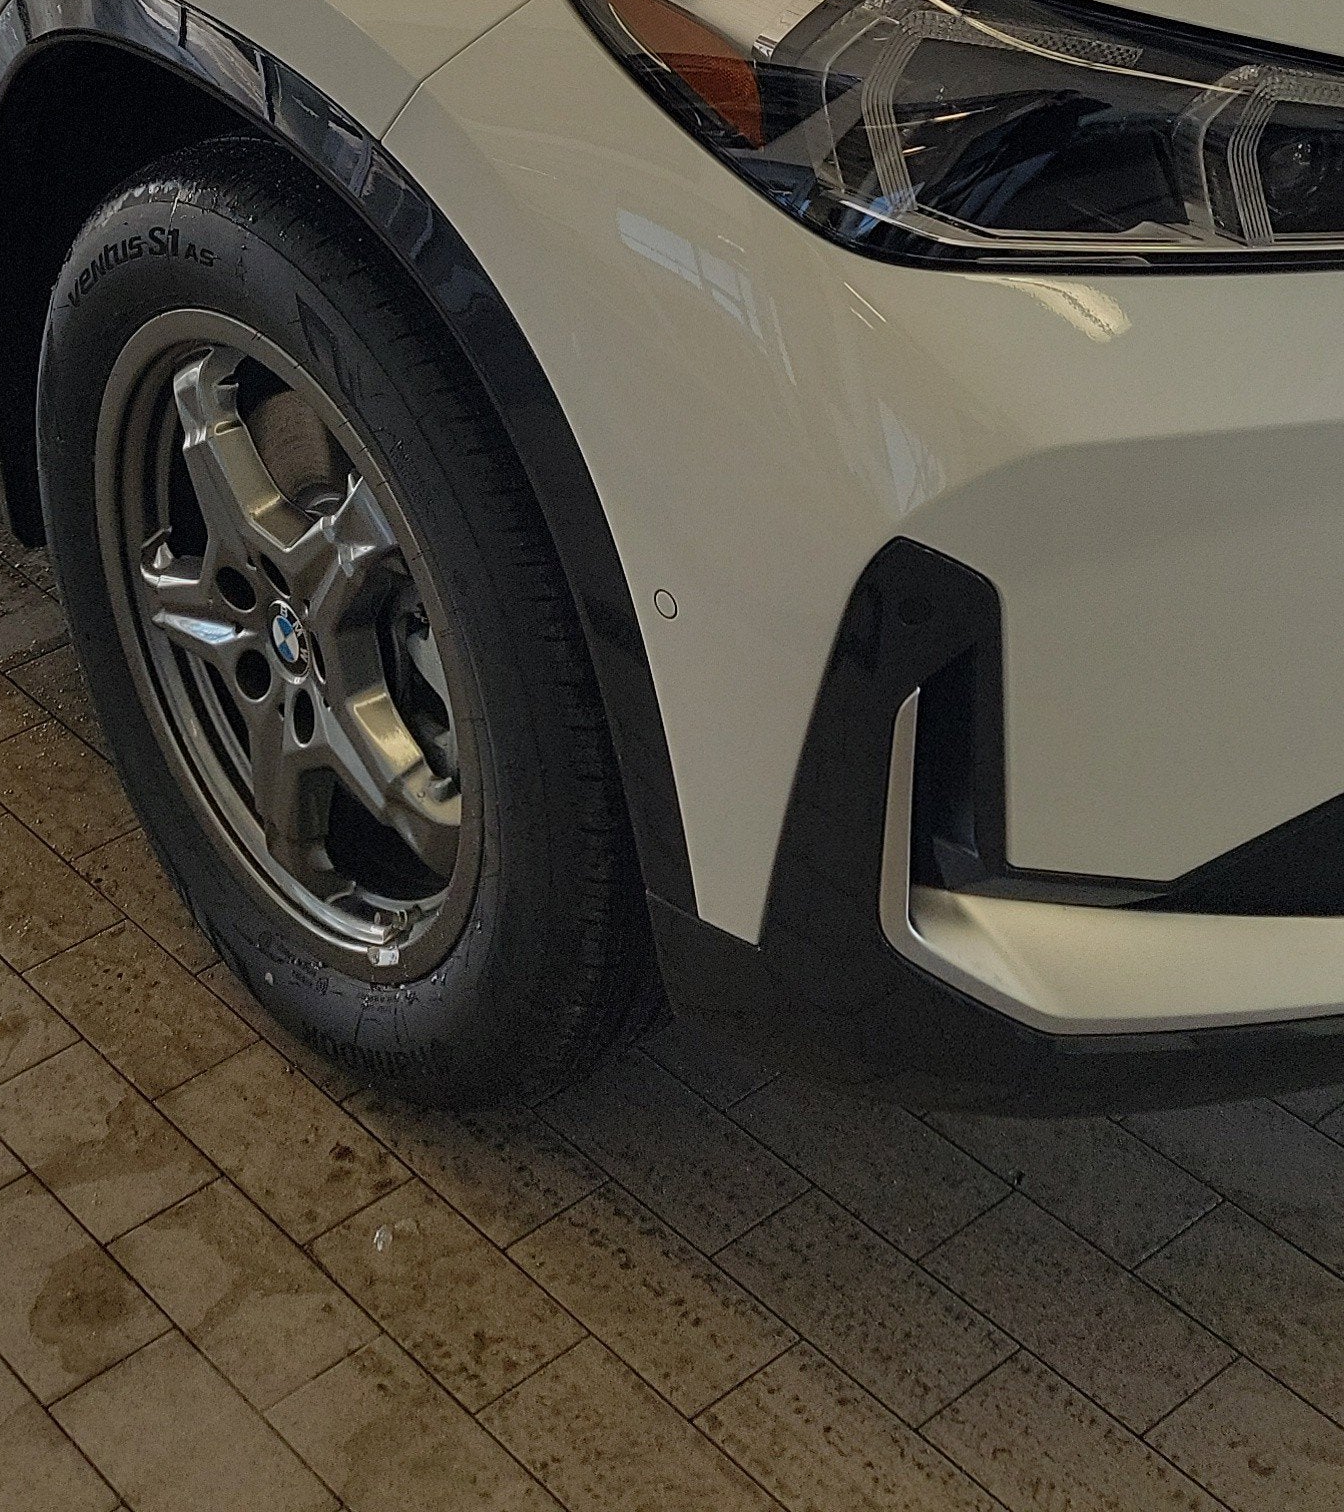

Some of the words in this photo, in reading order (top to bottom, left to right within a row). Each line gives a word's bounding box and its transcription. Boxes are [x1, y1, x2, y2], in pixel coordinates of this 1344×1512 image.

[148, 226, 180, 257] S1
[185, 242, 216, 267] AS
[280, 603, 309, 663] BMW
